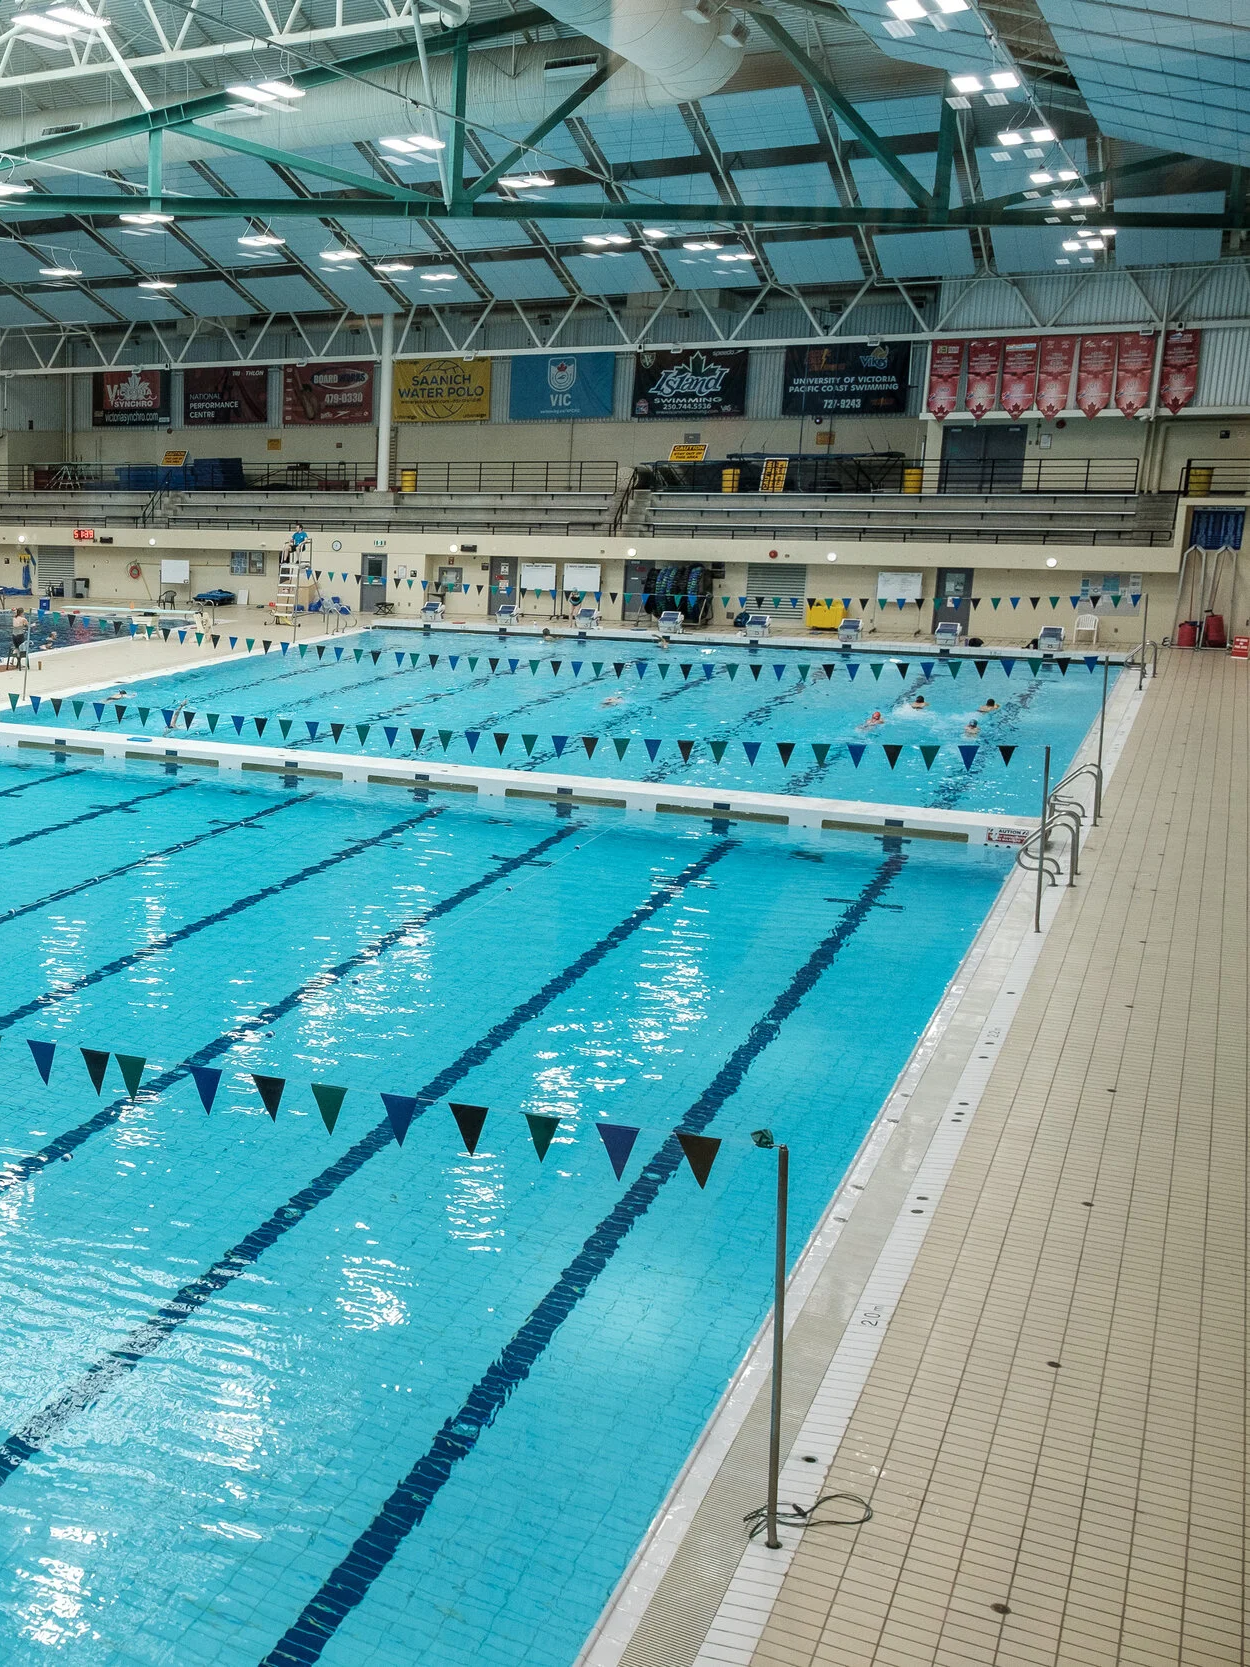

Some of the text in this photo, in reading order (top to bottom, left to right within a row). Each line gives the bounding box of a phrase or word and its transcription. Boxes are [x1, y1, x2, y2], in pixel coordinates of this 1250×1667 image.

[411, 374, 471, 386] SAANICH
[793, 377, 841, 385] UNIVERSITY
[857, 375, 896, 383] VICTORIA
[398, 386, 484, 398] WATER POLO
[789, 385, 819, 393] PACIFIC
[850, 383, 899, 391] SWIMMING
[324, 393, 363, 404] 479-0330
[550, 394, 572, 407] VIC
[114, 400, 153, 408] SYNCHRO
[190, 401, 239, 409] PERFORMANCE
[823, 399, 861, 409] 727-9243
